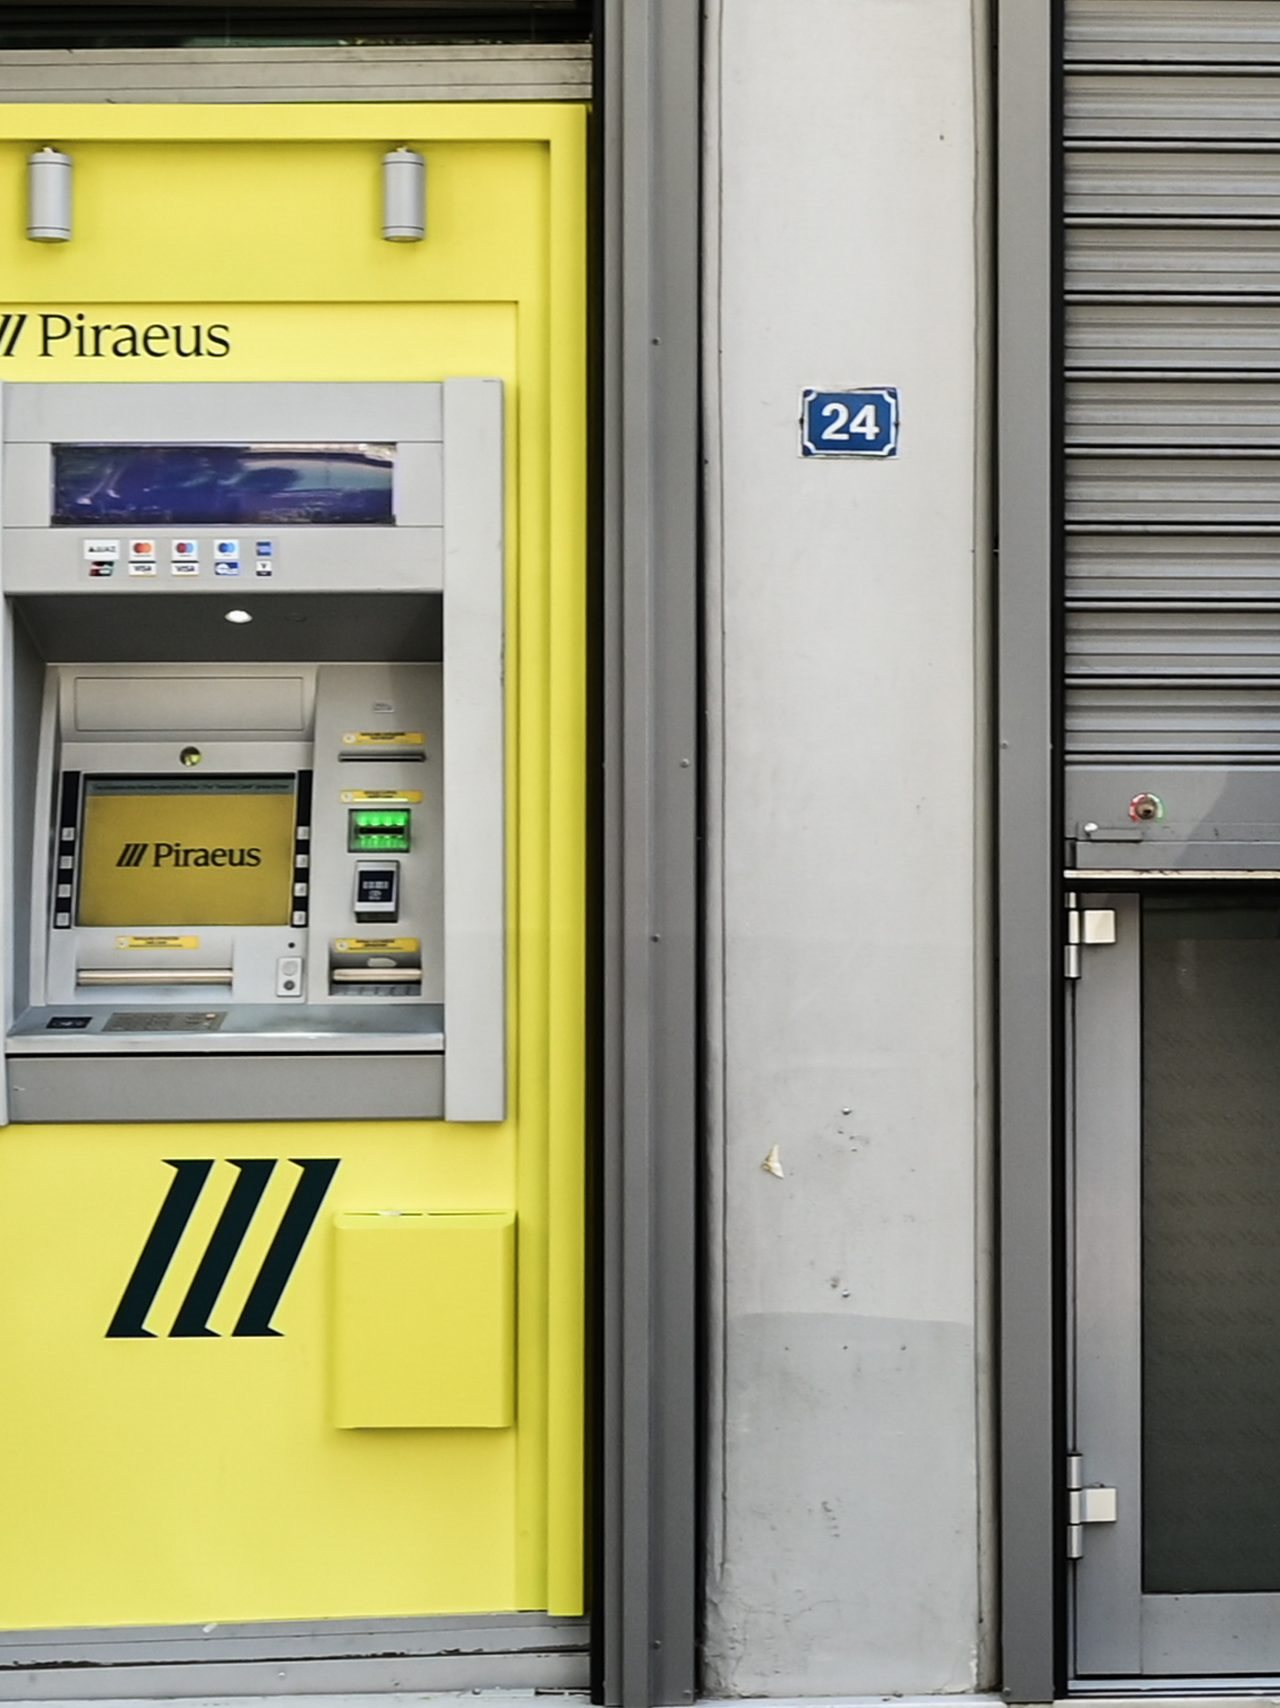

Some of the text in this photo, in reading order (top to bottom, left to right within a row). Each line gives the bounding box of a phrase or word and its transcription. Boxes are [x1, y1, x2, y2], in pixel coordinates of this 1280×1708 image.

[37, 313, 230, 358] Piraeus
[821, 402, 880, 440] 24
[152, 843, 262, 868] Piraeus
